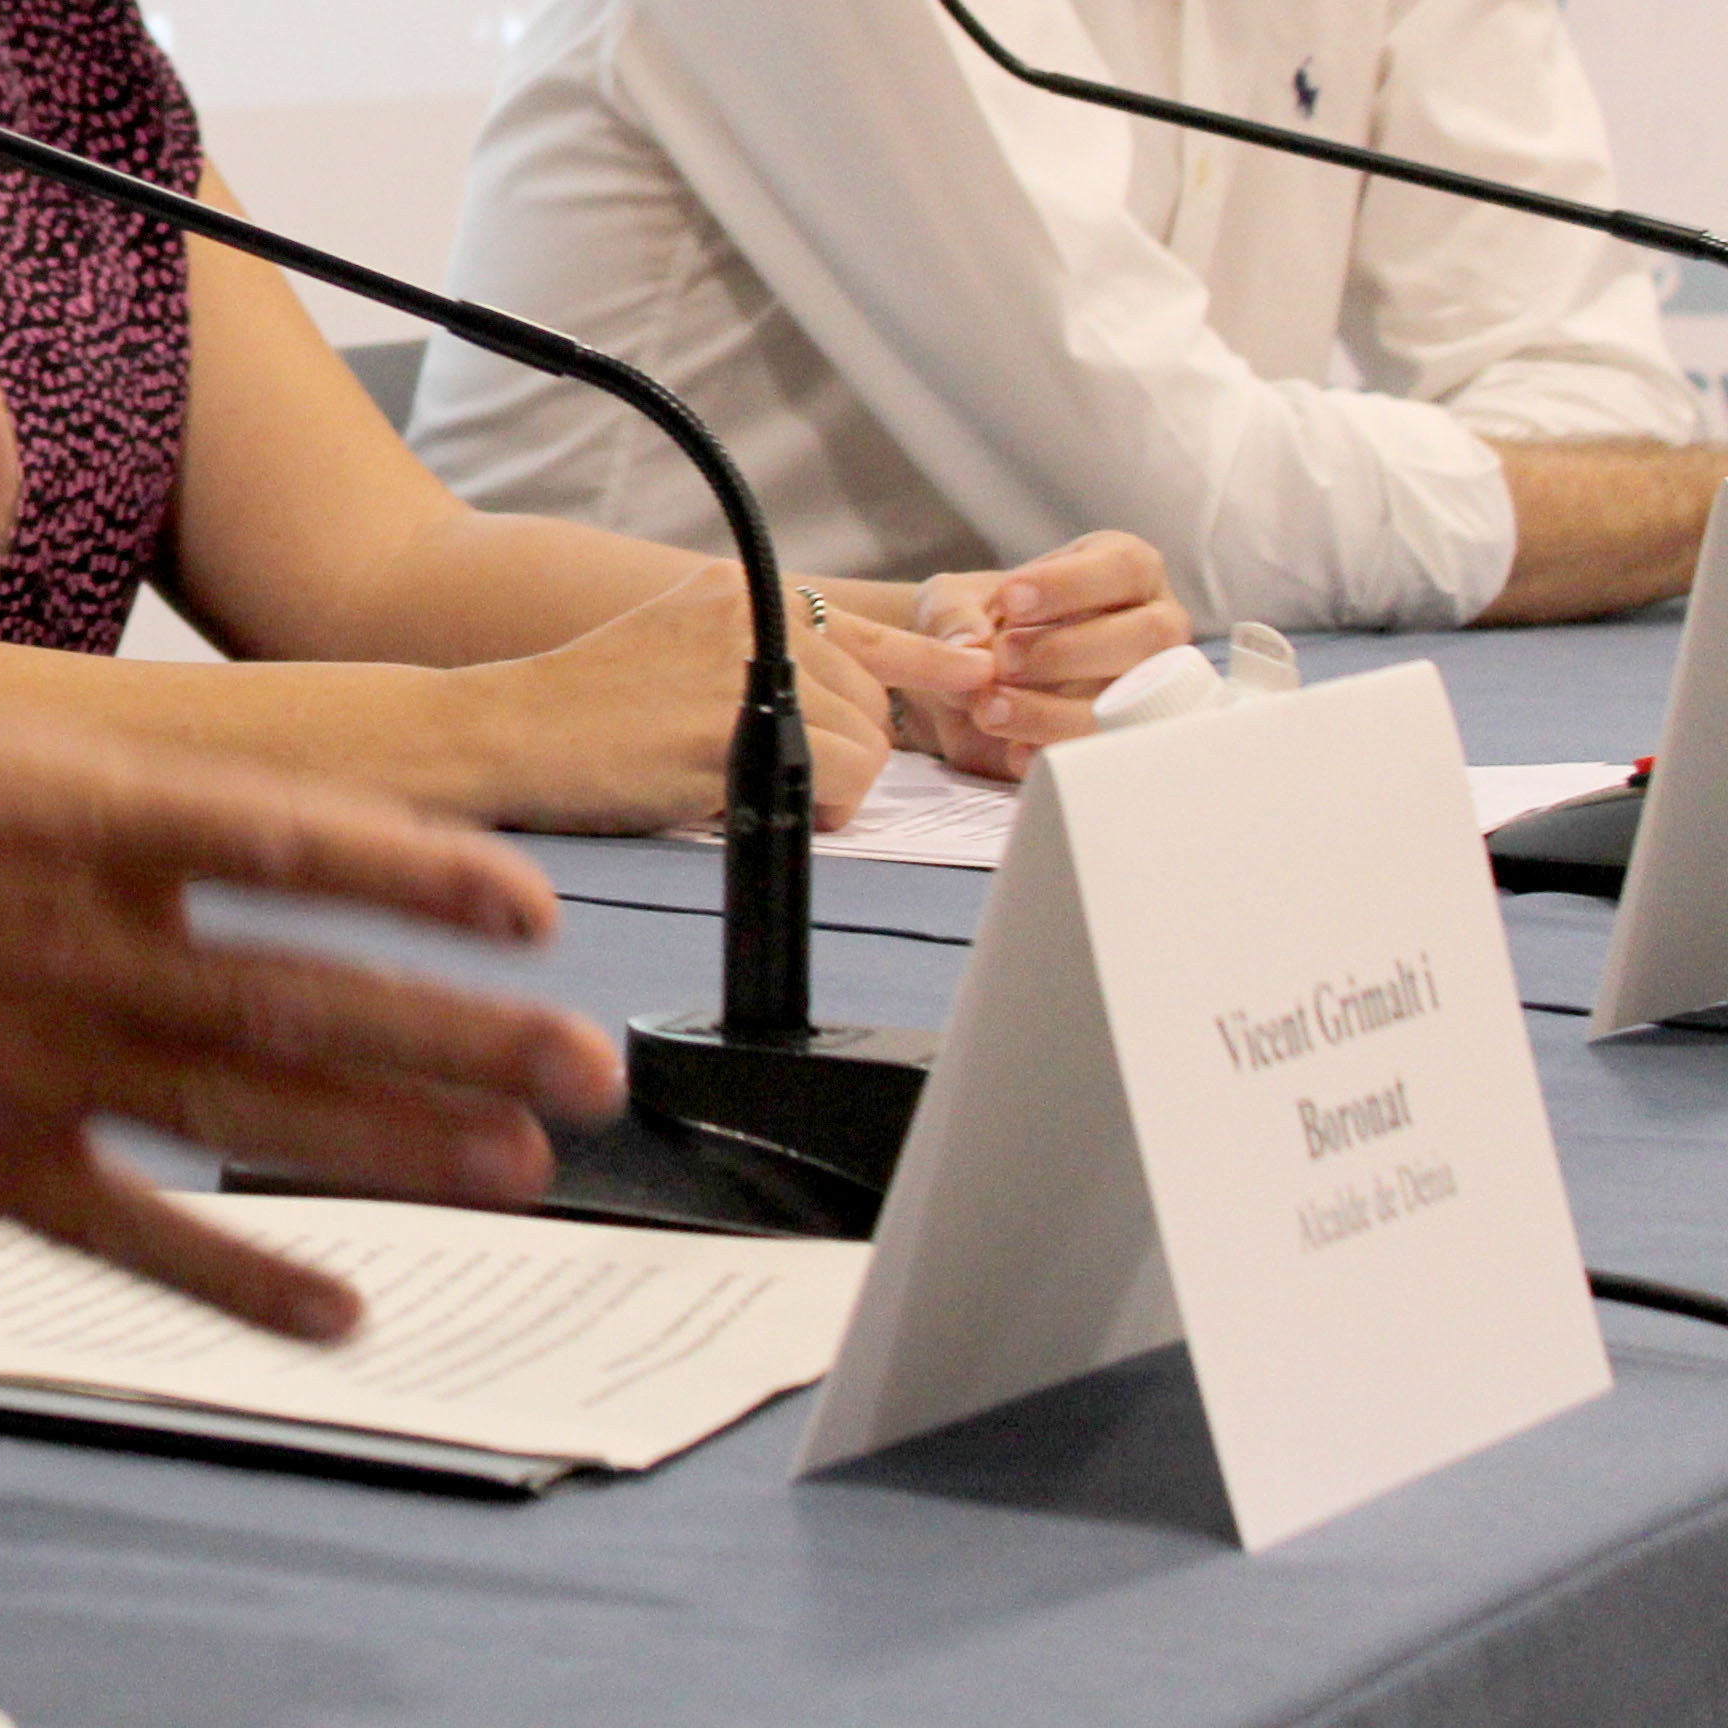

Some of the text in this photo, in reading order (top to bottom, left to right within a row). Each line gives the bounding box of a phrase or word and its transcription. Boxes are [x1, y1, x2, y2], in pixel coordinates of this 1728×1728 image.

[1215, 1002, 1314, 1071] Vicent
[1315, 960, 1422, 1045] Grimalt
[1297, 1079, 1412, 1160] Boronat
